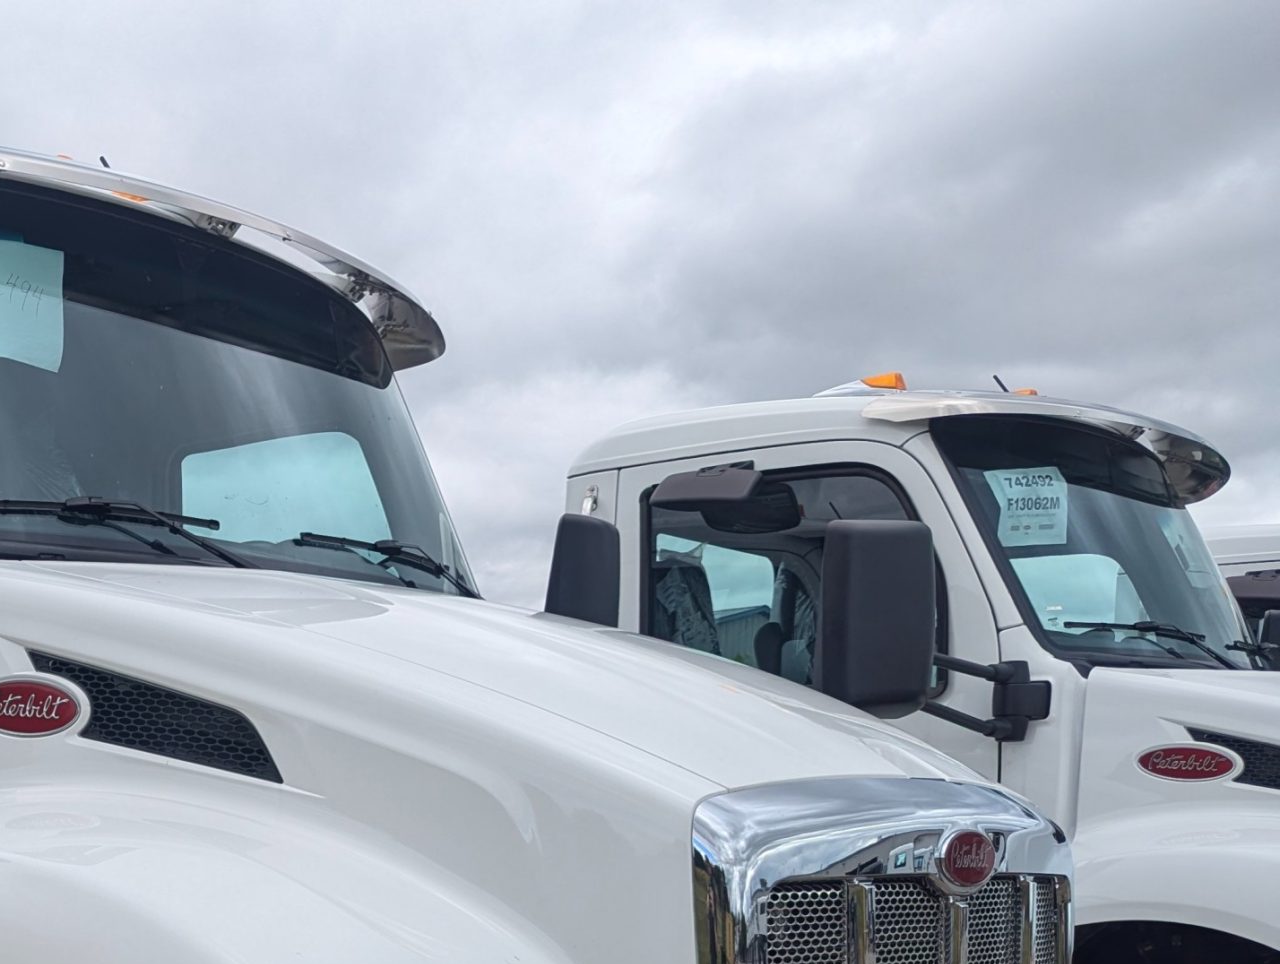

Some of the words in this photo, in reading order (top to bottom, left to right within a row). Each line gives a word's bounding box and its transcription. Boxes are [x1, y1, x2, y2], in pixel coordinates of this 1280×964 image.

[1004, 474, 1054, 489] 742492
[1007, 496, 1060, 511] F13062M
[1148, 750, 1227, 772] Peterbilt
[950, 837, 993, 872] Peterbilt
